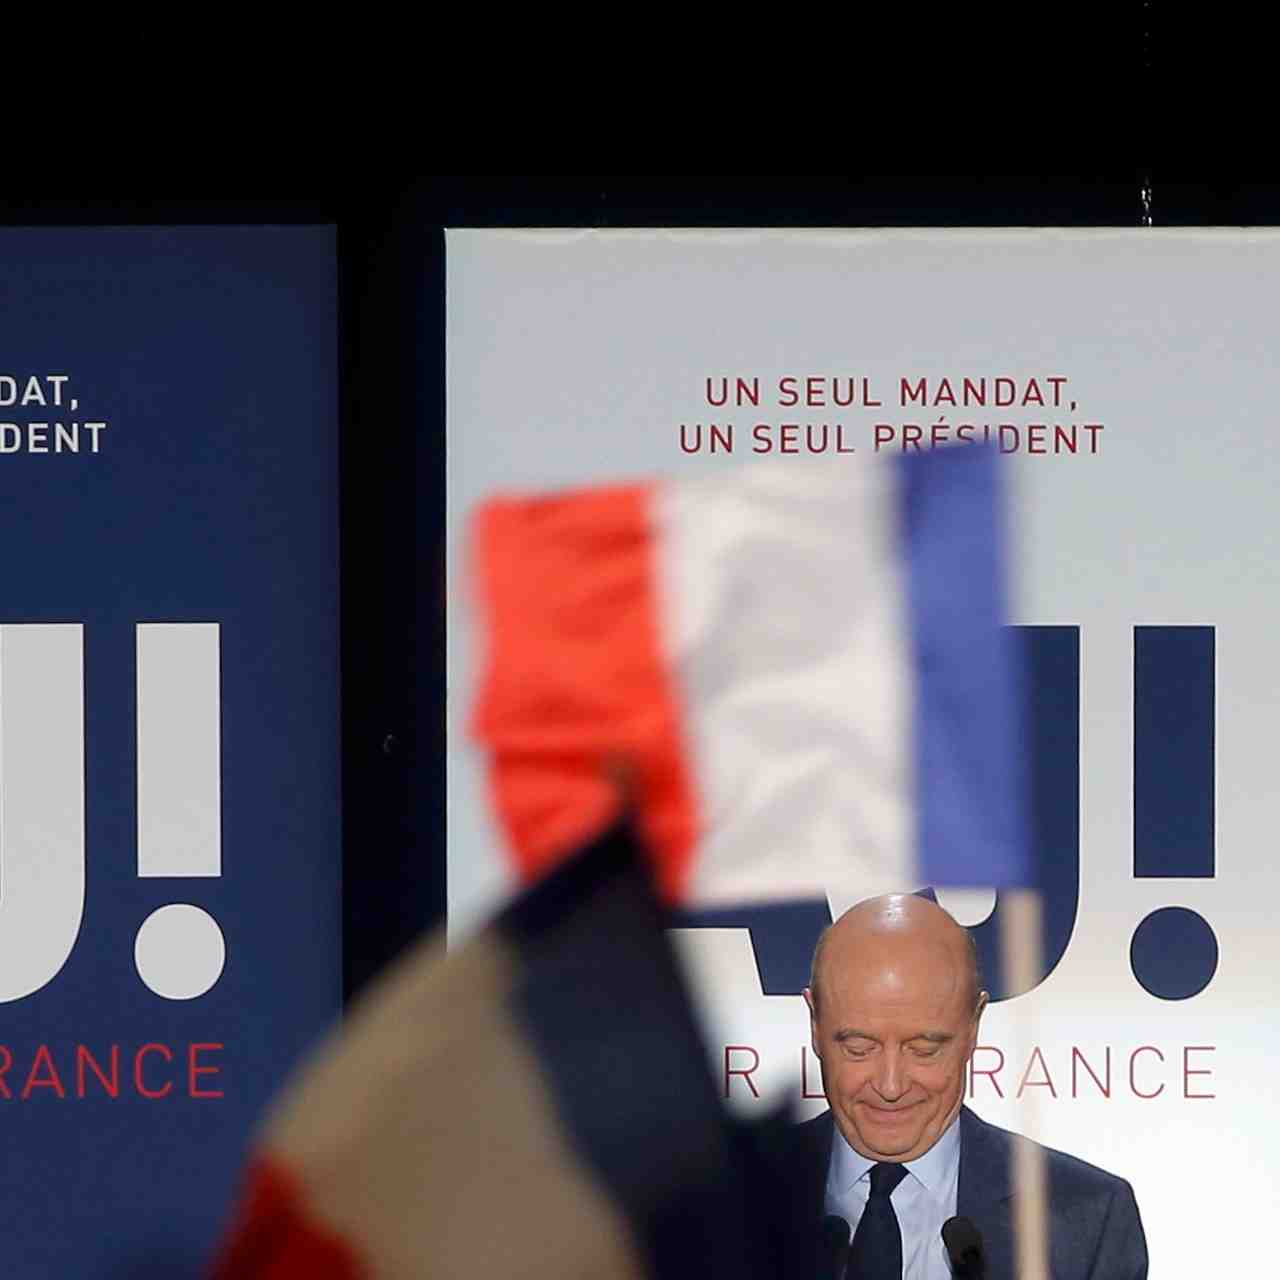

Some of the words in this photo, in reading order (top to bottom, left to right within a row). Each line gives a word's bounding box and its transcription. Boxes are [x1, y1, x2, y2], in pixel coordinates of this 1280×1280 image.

[706, 377, 759, 407] UN
[778, 377, 882, 407] SEUL
[900, 377, 1077, 411] MANDAT,
[680, 424, 733, 454] UN
[752, 424, 855, 454] SEUL
[969, 1045, 1217, 1099] RANCE
